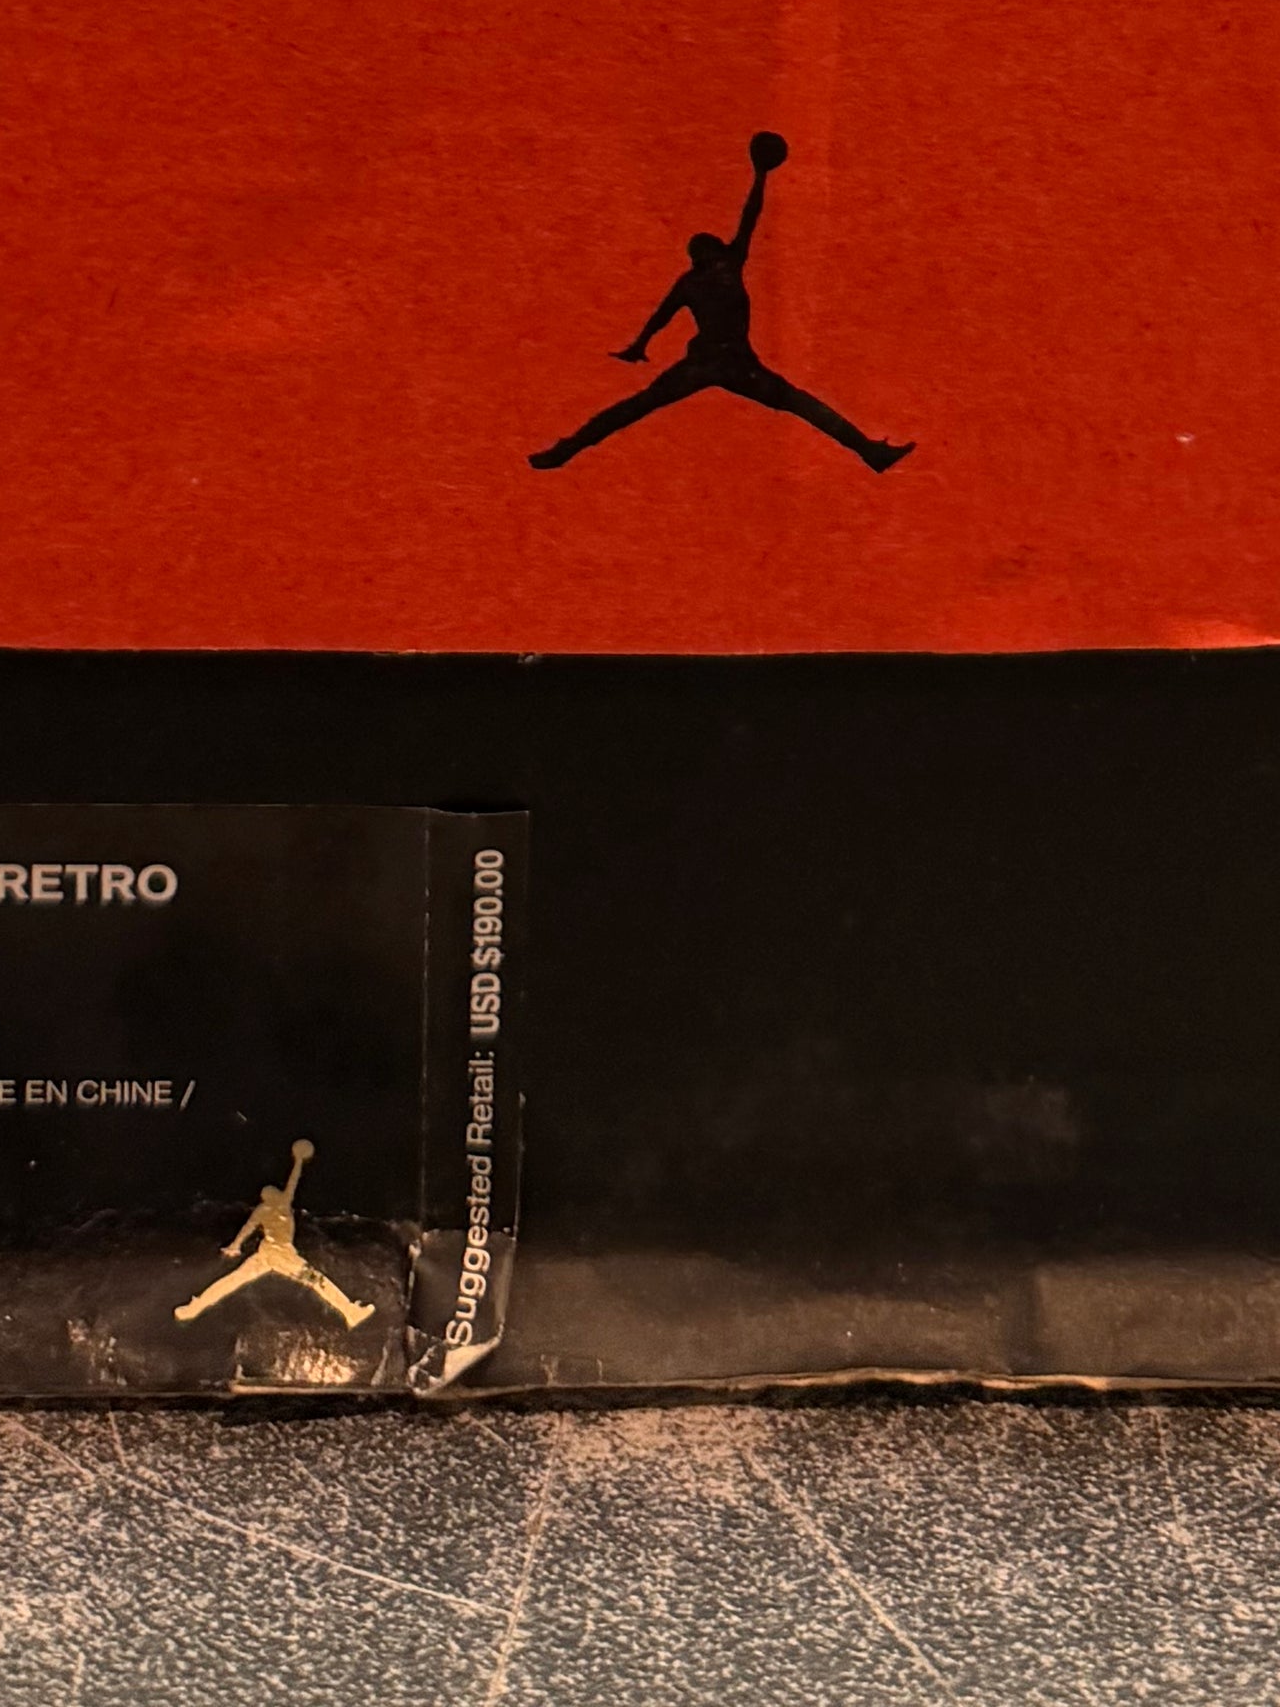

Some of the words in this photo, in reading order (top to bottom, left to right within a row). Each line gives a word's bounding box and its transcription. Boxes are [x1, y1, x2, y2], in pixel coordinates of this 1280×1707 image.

[471, 849, 505, 970] $190.00
[470, 971, 501, 1035] USD
[25, 1080, 67, 1105] EN
[76, 1080, 173, 1106] CHINE
[179, 1080, 196, 1110] /
[466, 1050, 495, 1145] Retail:
[445, 1154, 492, 1347] Suggested
